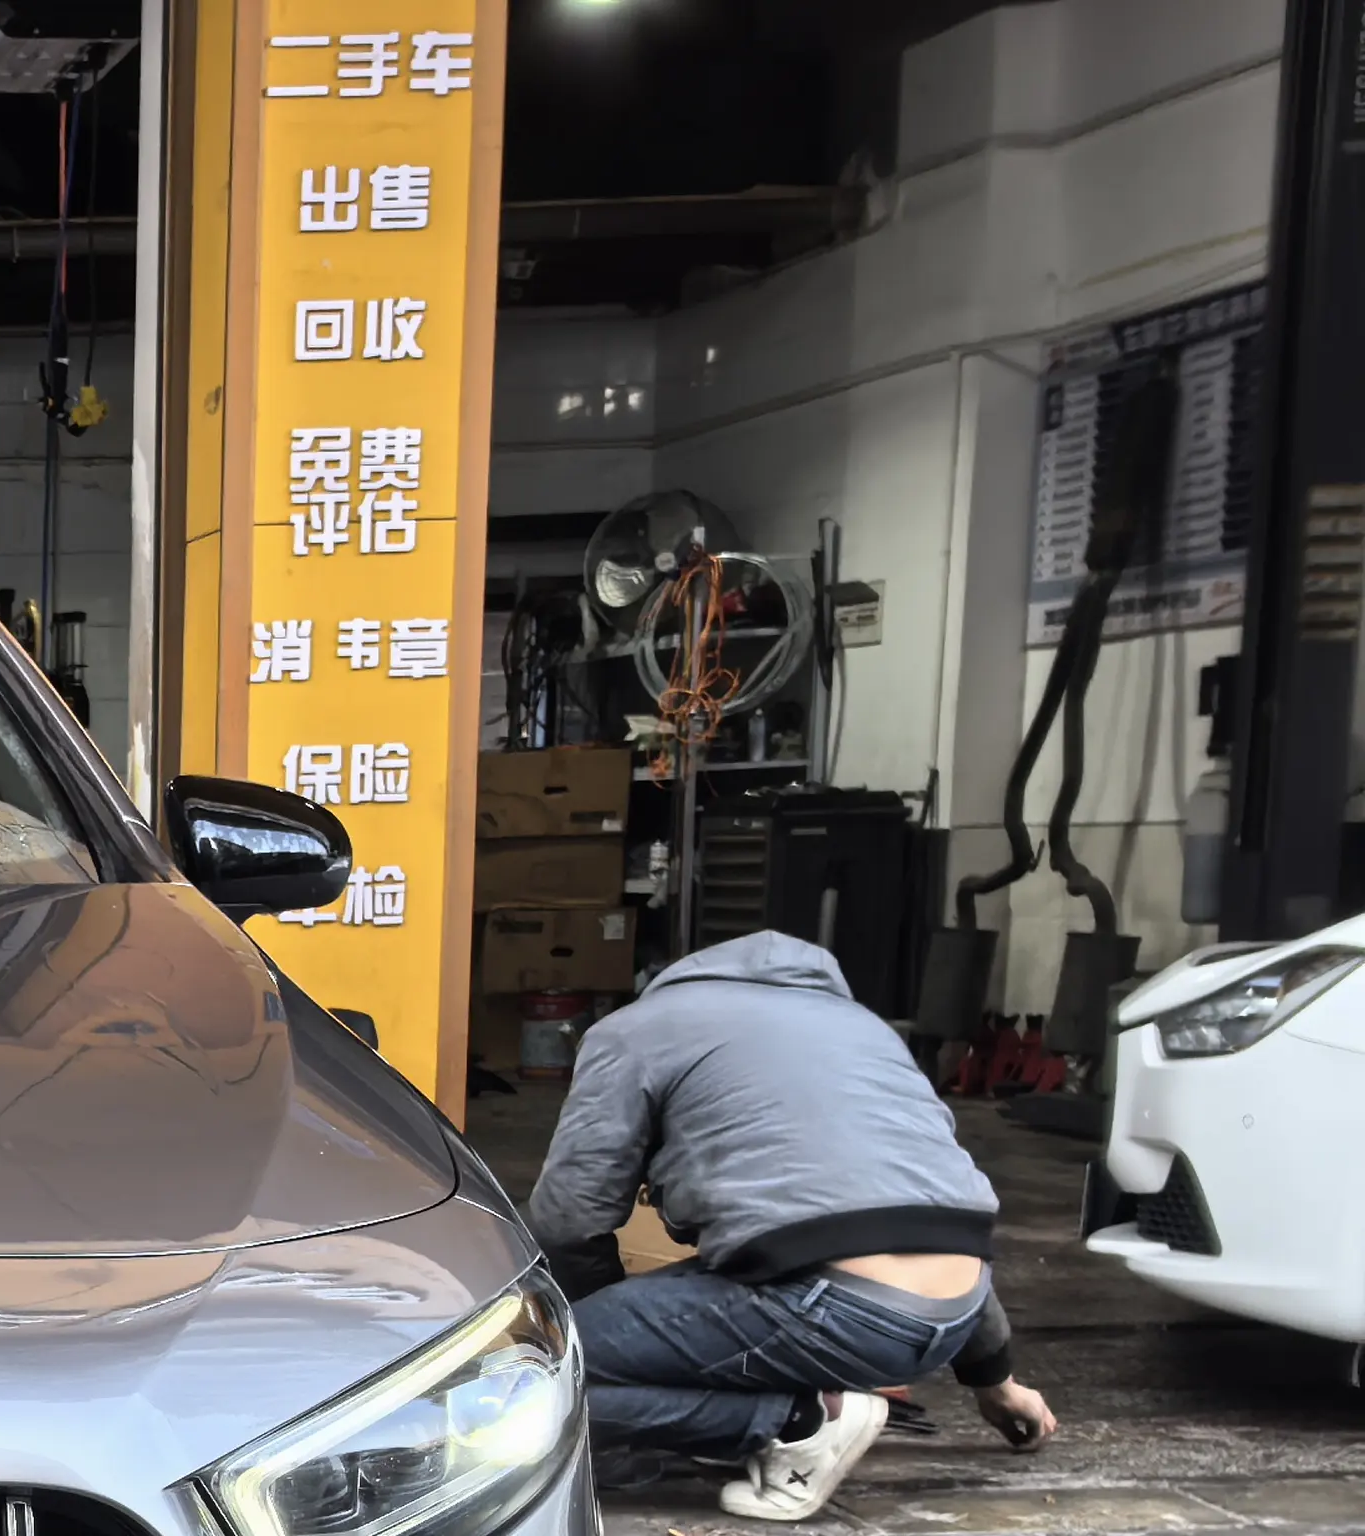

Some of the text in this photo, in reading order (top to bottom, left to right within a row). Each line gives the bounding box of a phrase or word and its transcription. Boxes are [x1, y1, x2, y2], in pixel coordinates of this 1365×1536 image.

[265, 31, 473, 96] 二手车
[300, 165, 430, 231] 出售
[295, 297, 427, 361] 回收
[290, 427, 422, 490] 免费
[289, 491, 418, 556] 评估
[282, 743, 411, 804] 保险
[278, 865, 407, 926] 检
